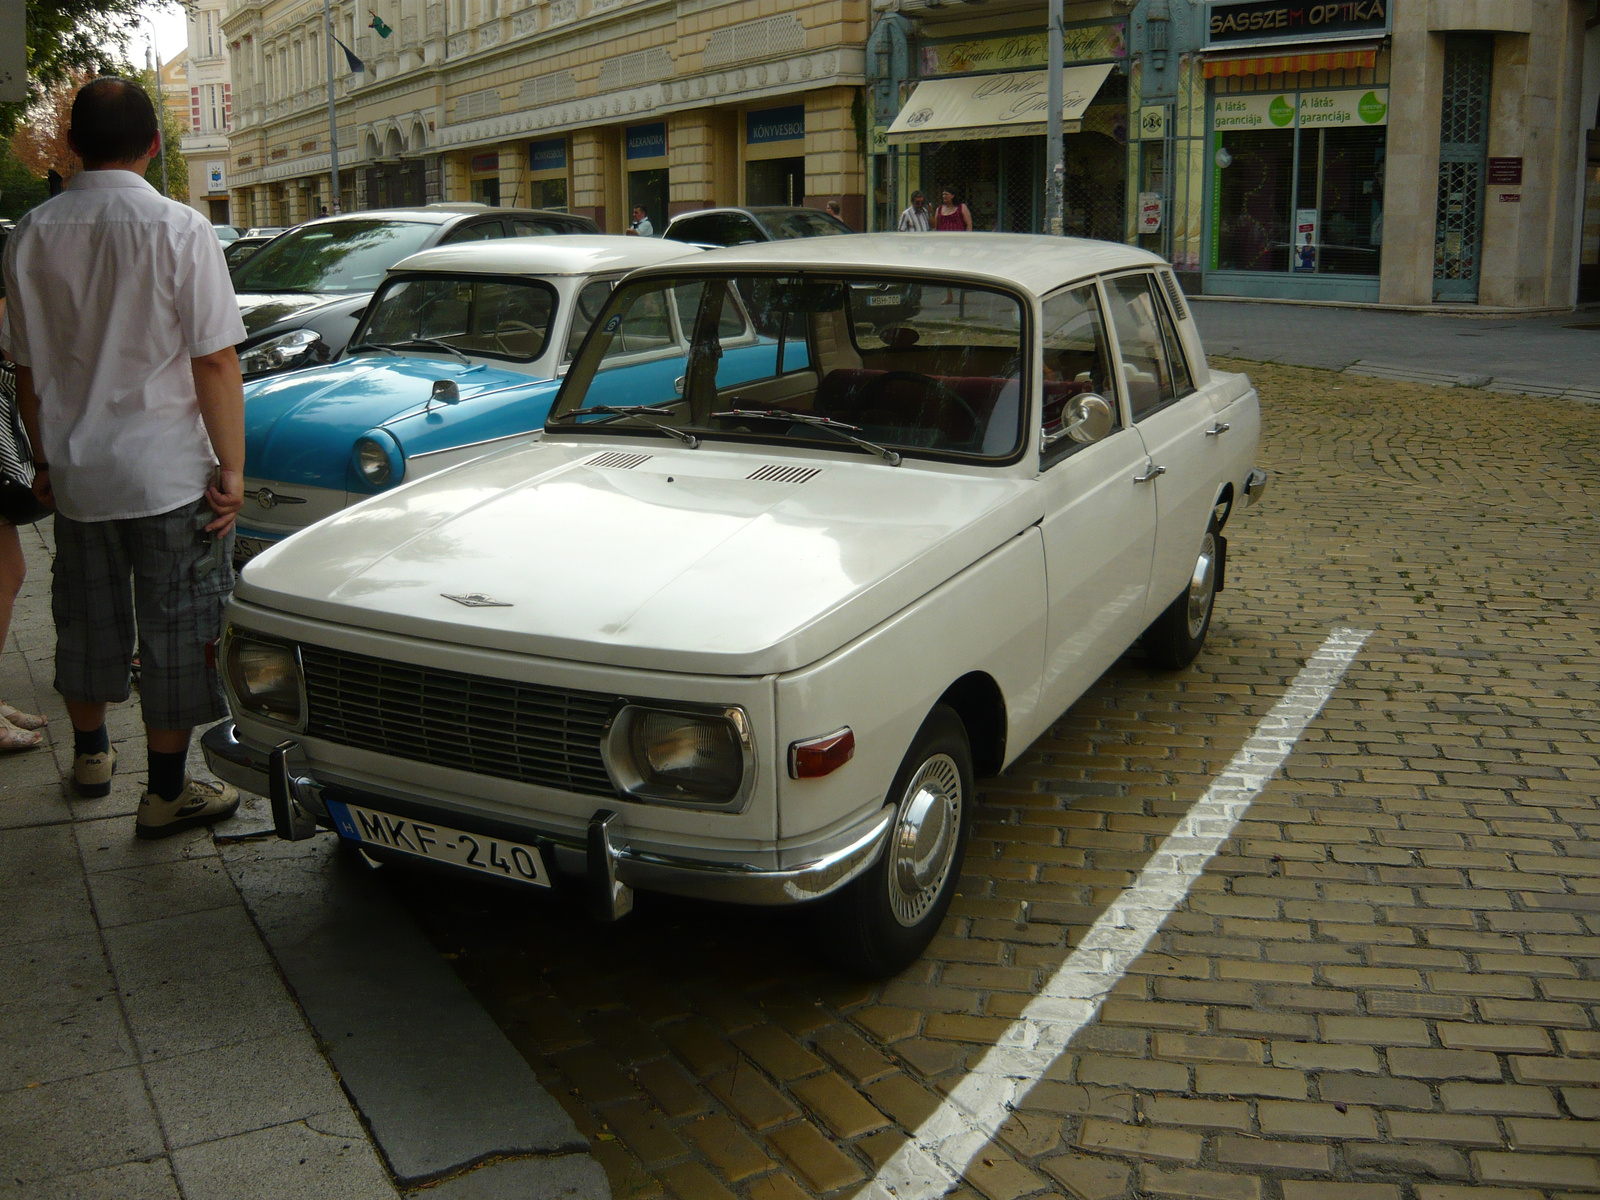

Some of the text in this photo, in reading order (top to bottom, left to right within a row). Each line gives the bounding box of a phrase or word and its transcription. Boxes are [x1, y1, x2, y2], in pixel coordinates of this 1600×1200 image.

[1210, 0, 1384, 34] SASSZEM OPTIKA
[996, 37, 1041, 61] Dekor
[972, 73, 1044, 100] Dekor
[1215, 98, 1246, 111] A látás
[1300, 95, 1334, 108] A látás
[1215, 114, 1262, 127] garanciája
[1300, 110, 1351, 125] garanciája
[753, 122, 804, 139] KÖNYVESBOL
[628, 134, 664, 149] ALEXANDRA
[341, 821, 354, 833] H
[355, 809, 538, 879] MKF-240
